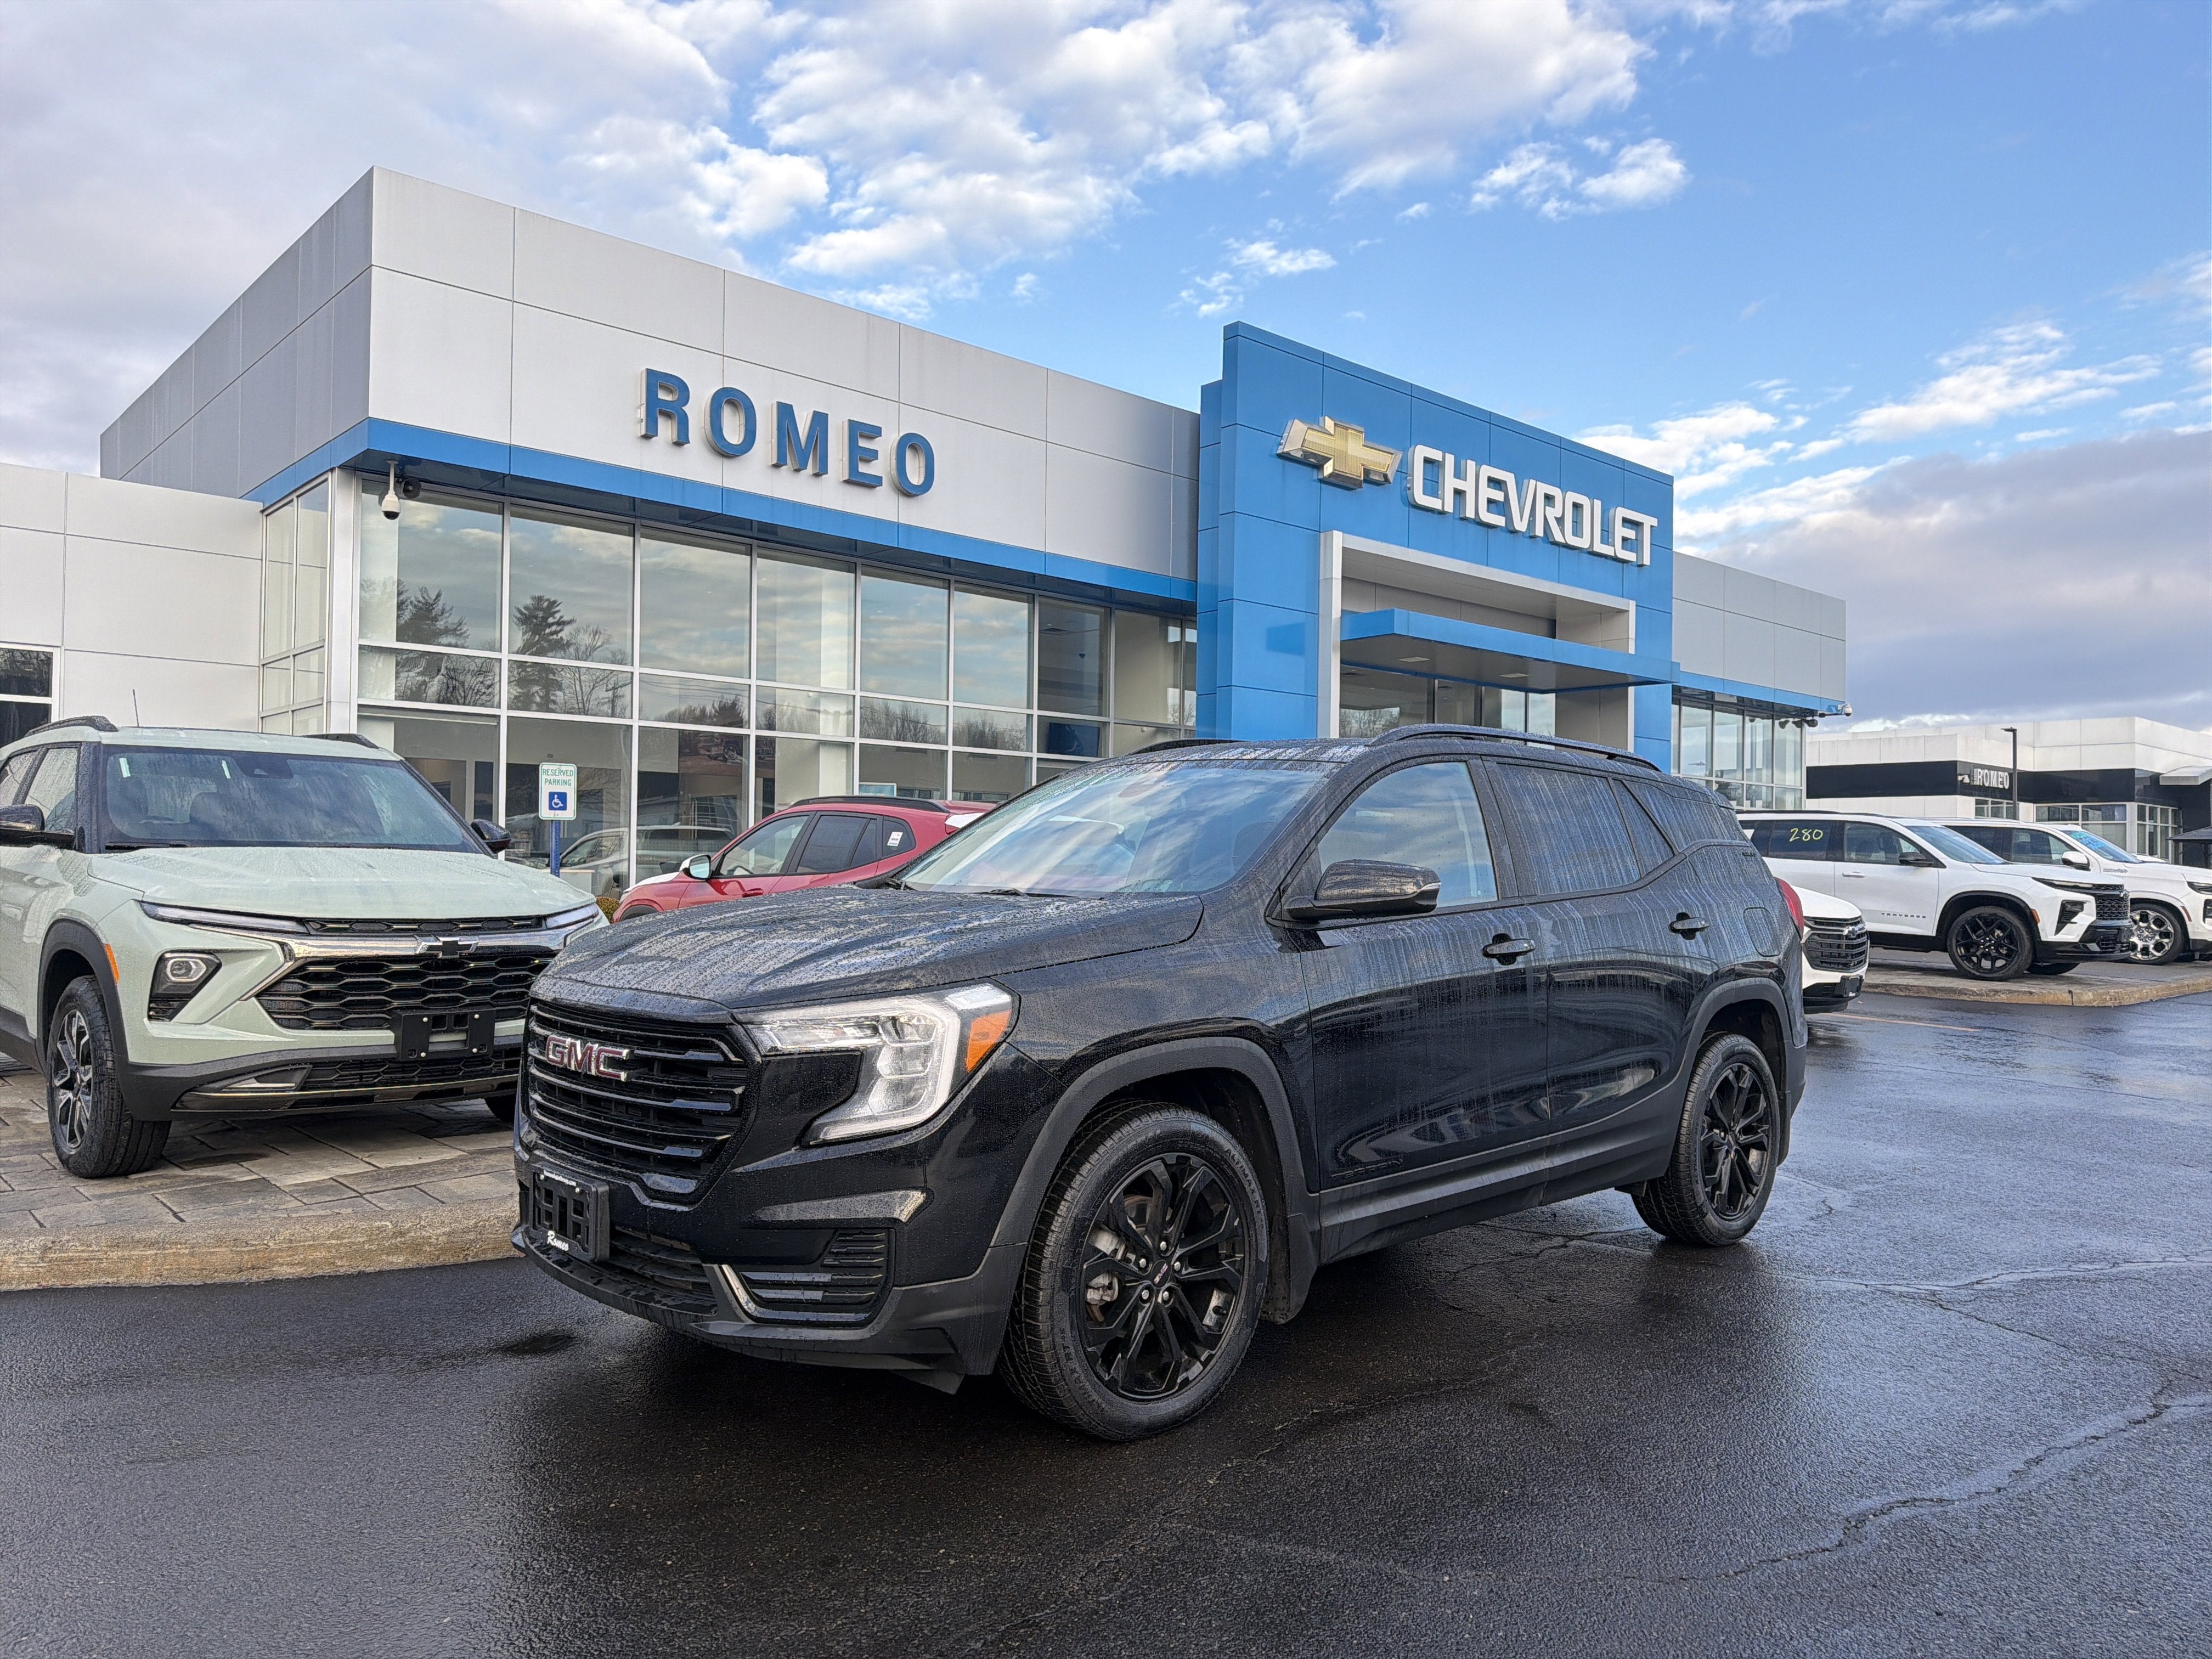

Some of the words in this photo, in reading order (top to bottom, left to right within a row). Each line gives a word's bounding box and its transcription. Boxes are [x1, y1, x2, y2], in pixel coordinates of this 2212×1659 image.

[640, 368, 935, 496] ROMEO
[1408, 444, 1658, 566] CHEVROLET
[543, 769, 574, 777] RESERVED
[544, 778, 572, 786] PARKING
[1976, 768, 2010, 789] ROMEO
[1790, 827, 1823, 842] 280
[545, 1034, 630, 1082] GMC
[546, 1230, 569, 1251] Romeo
